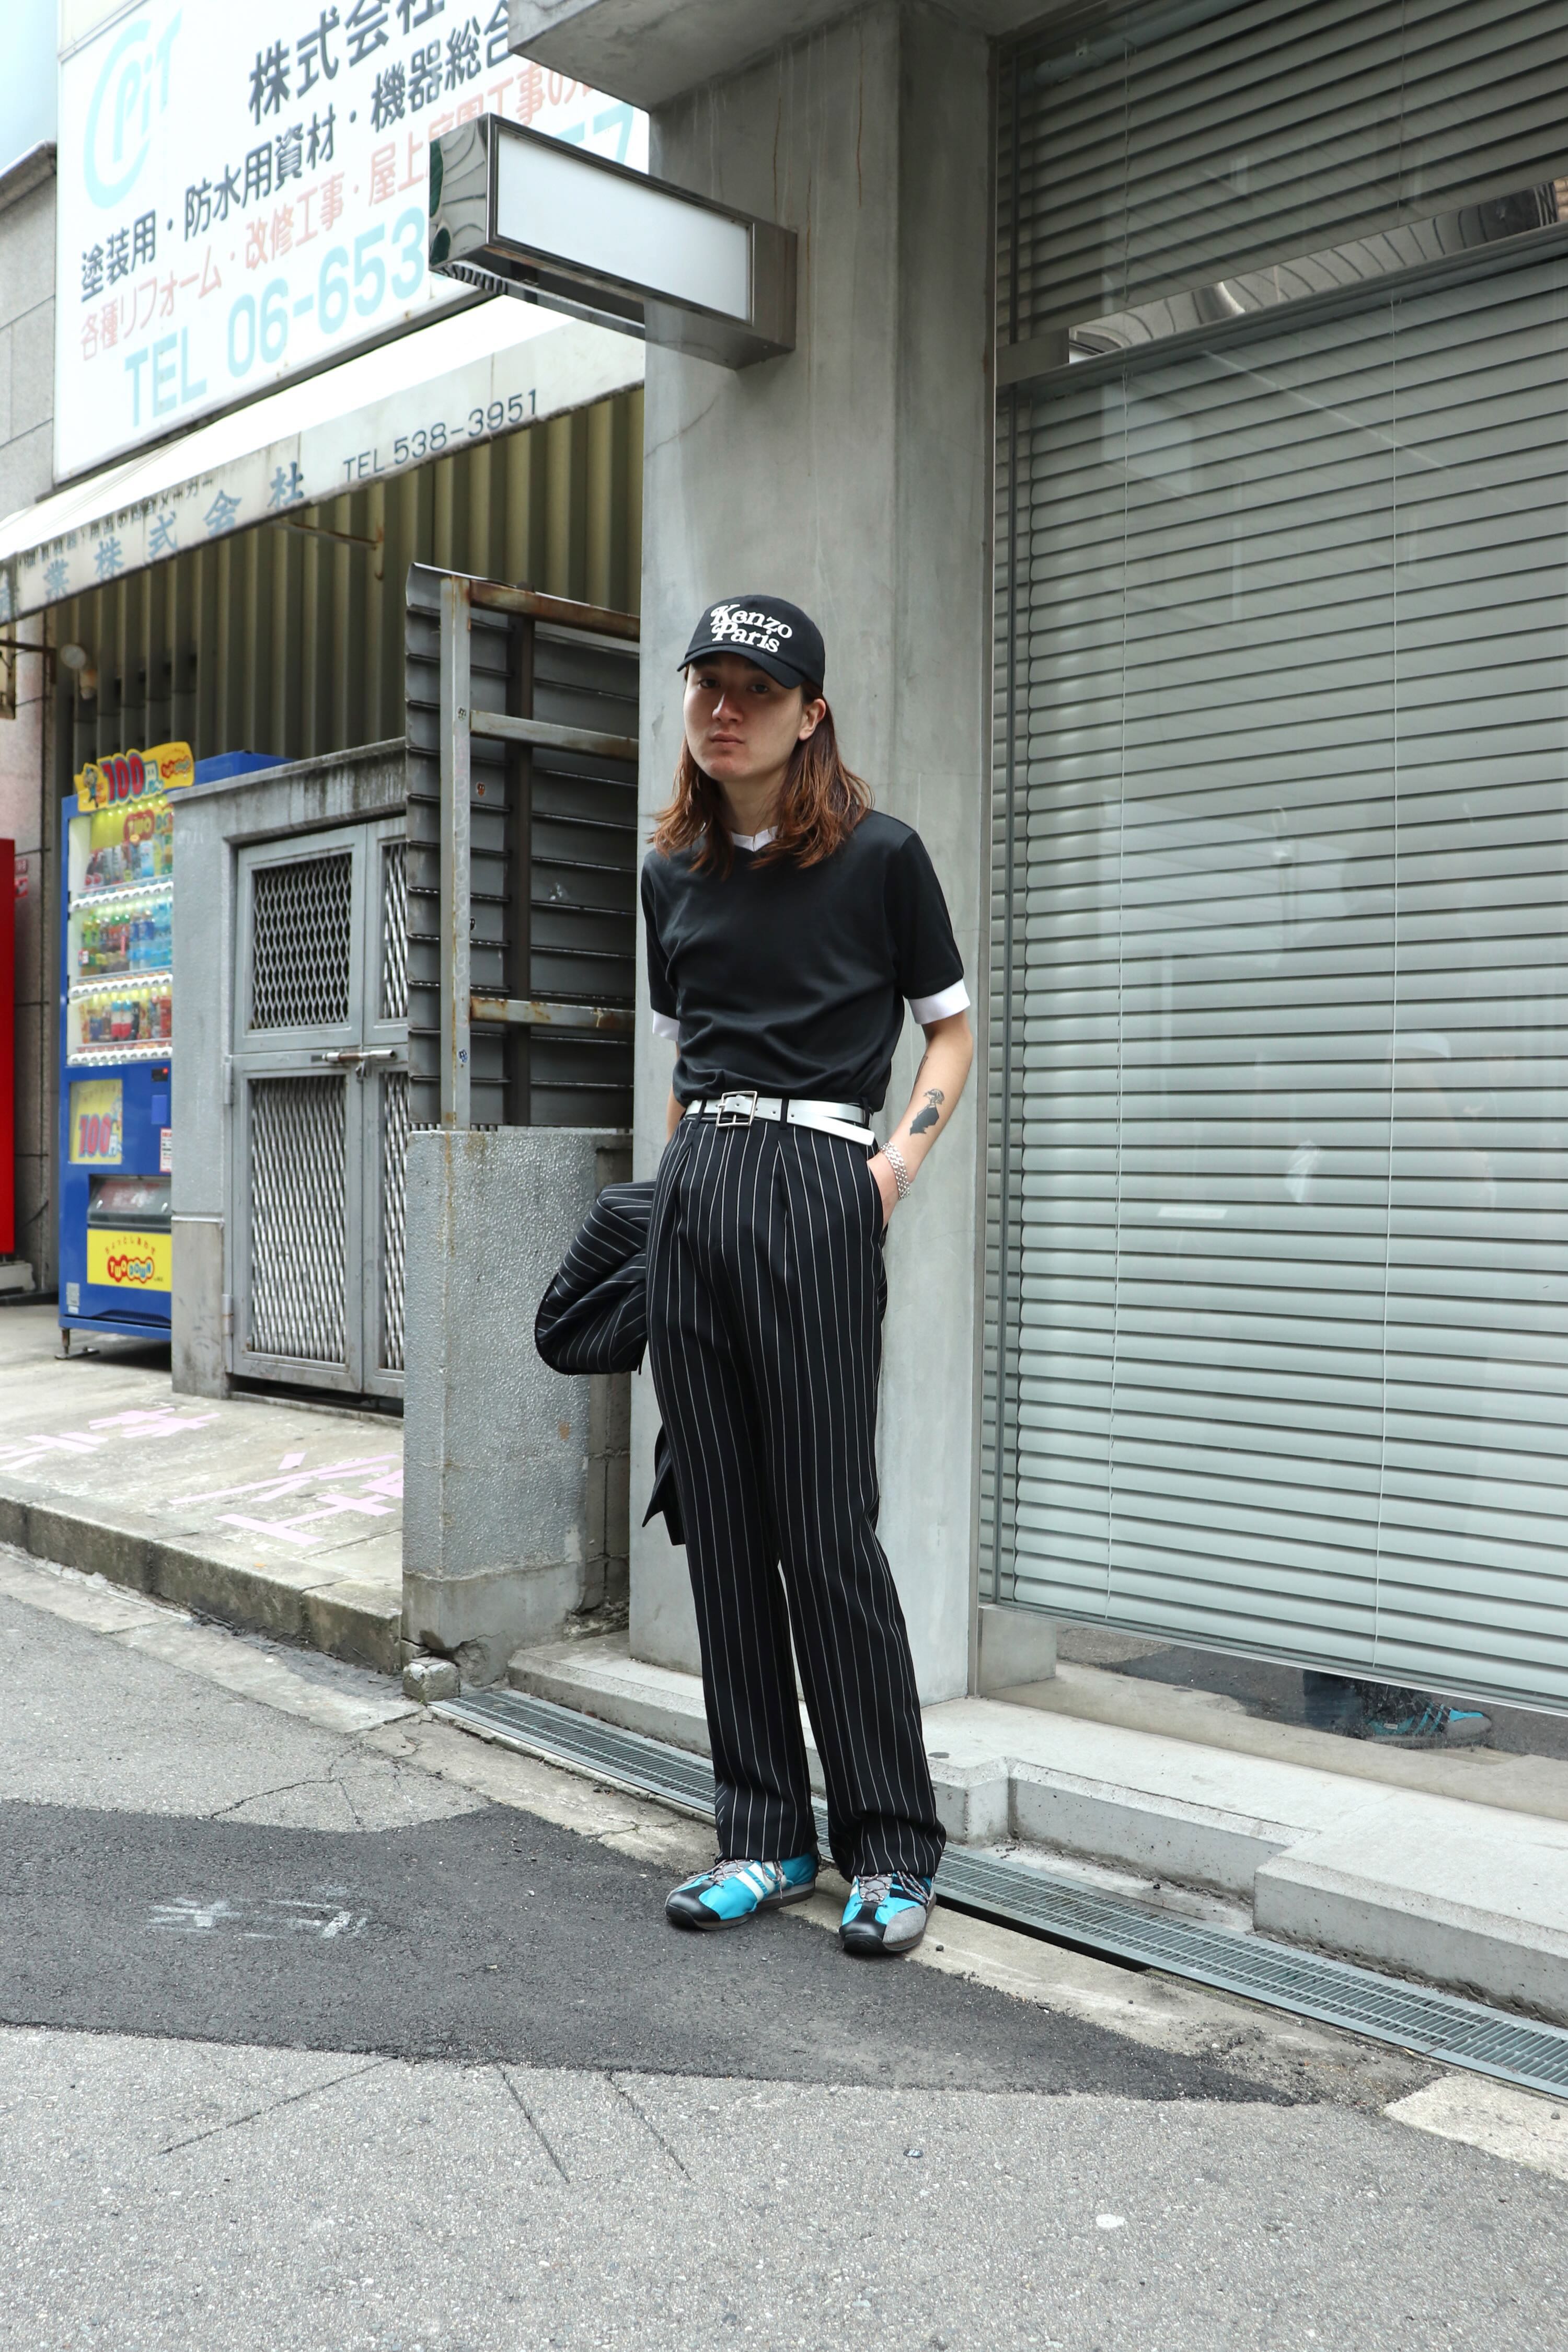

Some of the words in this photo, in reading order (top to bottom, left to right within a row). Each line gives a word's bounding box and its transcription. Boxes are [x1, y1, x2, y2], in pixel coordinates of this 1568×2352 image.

[124, 325, 207, 428] TEL
[343, 448, 386, 482] TEL
[394, 388, 536, 465] 538-3951
[710, 604, 793, 639] Kenzo
[711, 621, 780, 653] Paris
